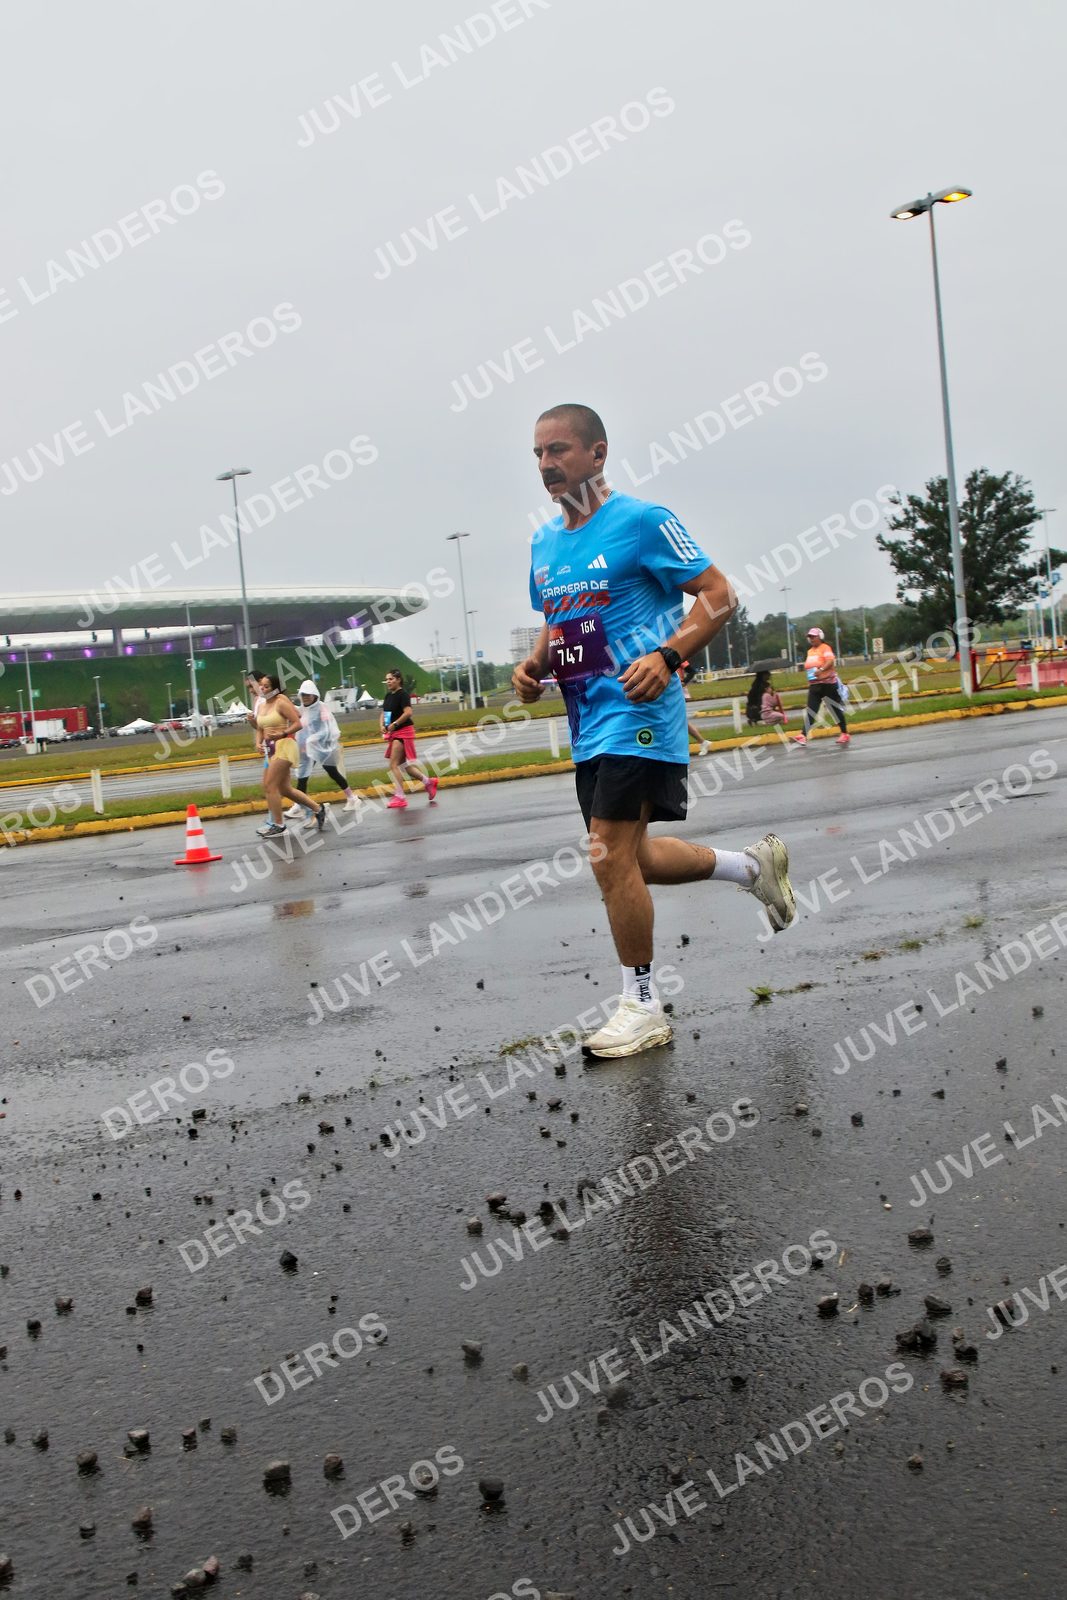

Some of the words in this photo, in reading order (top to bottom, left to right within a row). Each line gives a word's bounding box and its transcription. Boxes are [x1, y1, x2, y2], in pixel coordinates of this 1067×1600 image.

[543, 581, 588, 599] CARRERA
[590, 580, 609, 590] DE
[580, 619, 596, 634] 16K
[557, 645, 584, 666] 747
